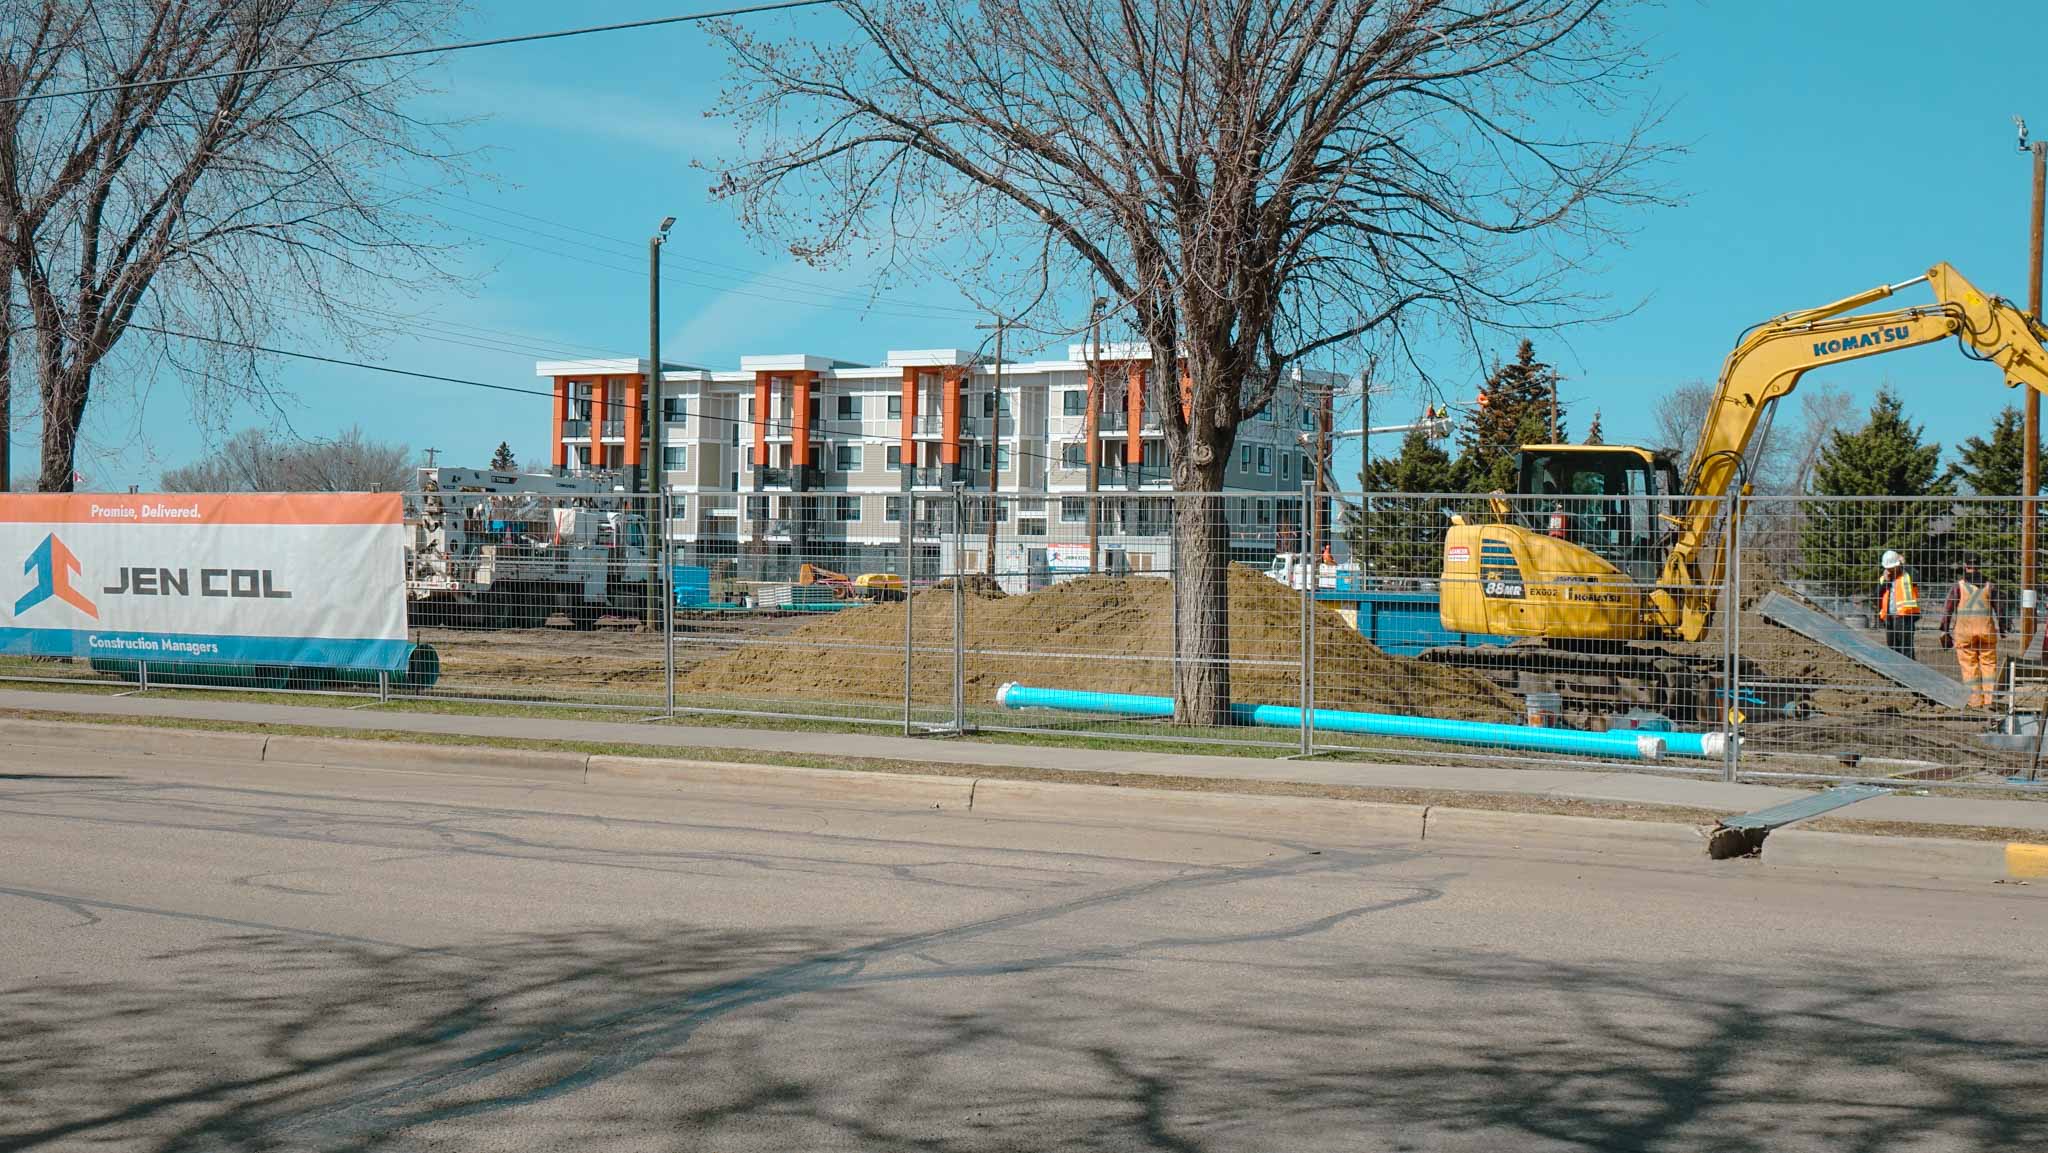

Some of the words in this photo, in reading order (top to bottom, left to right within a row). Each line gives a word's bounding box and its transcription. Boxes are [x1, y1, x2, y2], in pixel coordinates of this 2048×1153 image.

[1813, 325, 1909, 357] KOMATSU
[91, 504, 138, 519] Promise,
[142, 503, 201, 518] Delivered.
[103, 567, 189, 596] JEN
[200, 568, 292, 598] COL
[89, 635, 159, 650] Construction
[161, 638, 218, 656] Managers
